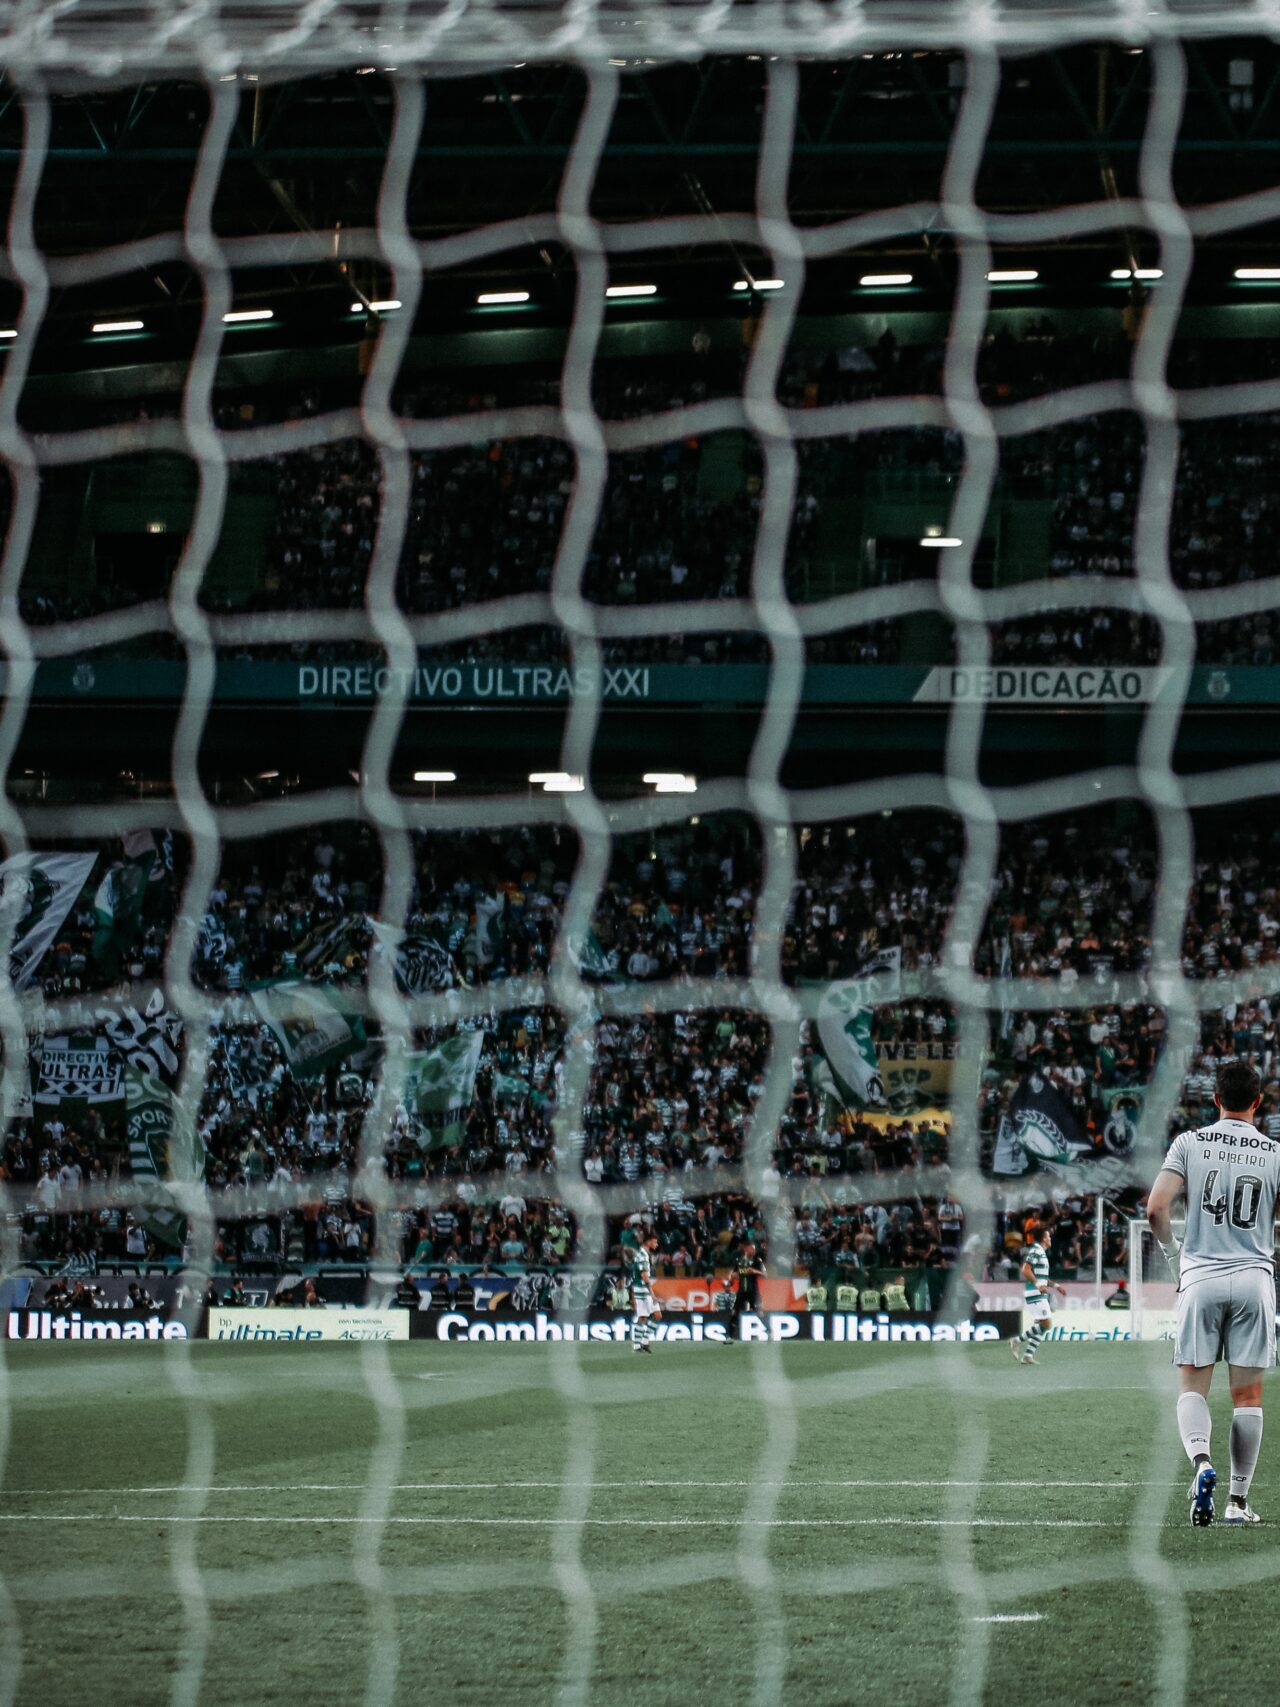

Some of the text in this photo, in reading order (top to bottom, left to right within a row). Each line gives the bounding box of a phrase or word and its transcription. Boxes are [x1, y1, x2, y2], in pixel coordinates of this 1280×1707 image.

[602, 667, 650, 697] XXI
[41, 1064, 118, 1080] ULTRAS
[1196, 1132, 1277, 1152] SUPER BOCK
[1218, 1151, 1266, 1168] RIBEIRO
[1201, 1169, 1264, 1231] 40
[7, 1311, 188, 1340] Ultimate
[218, 1324, 323, 1341] ultimate
[338, 1329, 395, 1340] ACTIVE
[739, 1312, 800, 1341] BP
[810, 1312, 1000, 1341] Ultimate
